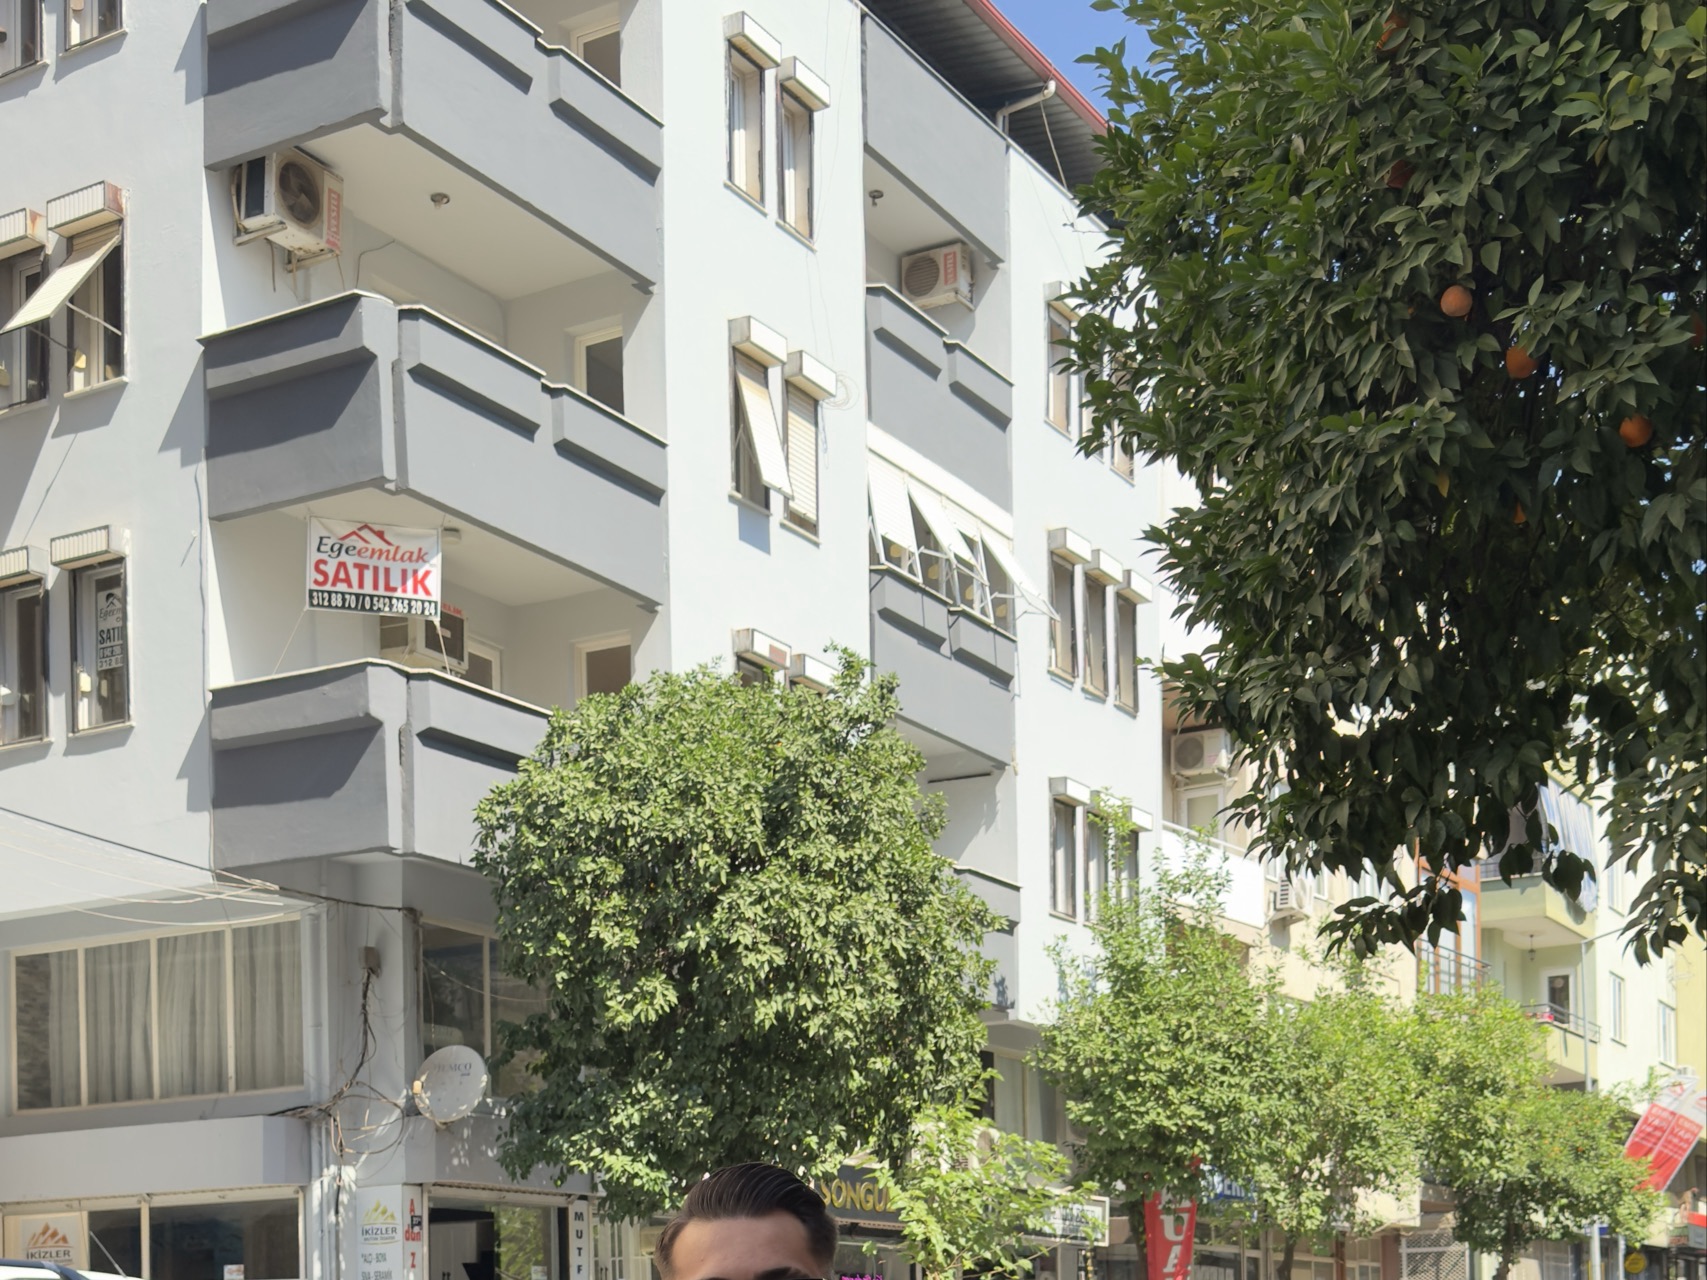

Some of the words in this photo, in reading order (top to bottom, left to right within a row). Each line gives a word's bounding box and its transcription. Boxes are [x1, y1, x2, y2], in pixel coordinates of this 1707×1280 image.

[313, 559, 432, 597] SATILIK
[312, 592, 329, 607] 312
[331, 593, 342, 608] 88
[345, 594, 356, 609] 70
[364, 595, 371, 610] 0
[372, 596, 390, 612] 542
[391, 597, 409, 614] 265
[411, 600, 422, 615] 20
[424, 601, 436, 616] 24
[361, 1226, 398, 1237] İKİZLER
[26, 1249, 71, 1260] İKİZLER
[410, 1251, 416, 1269] Z
